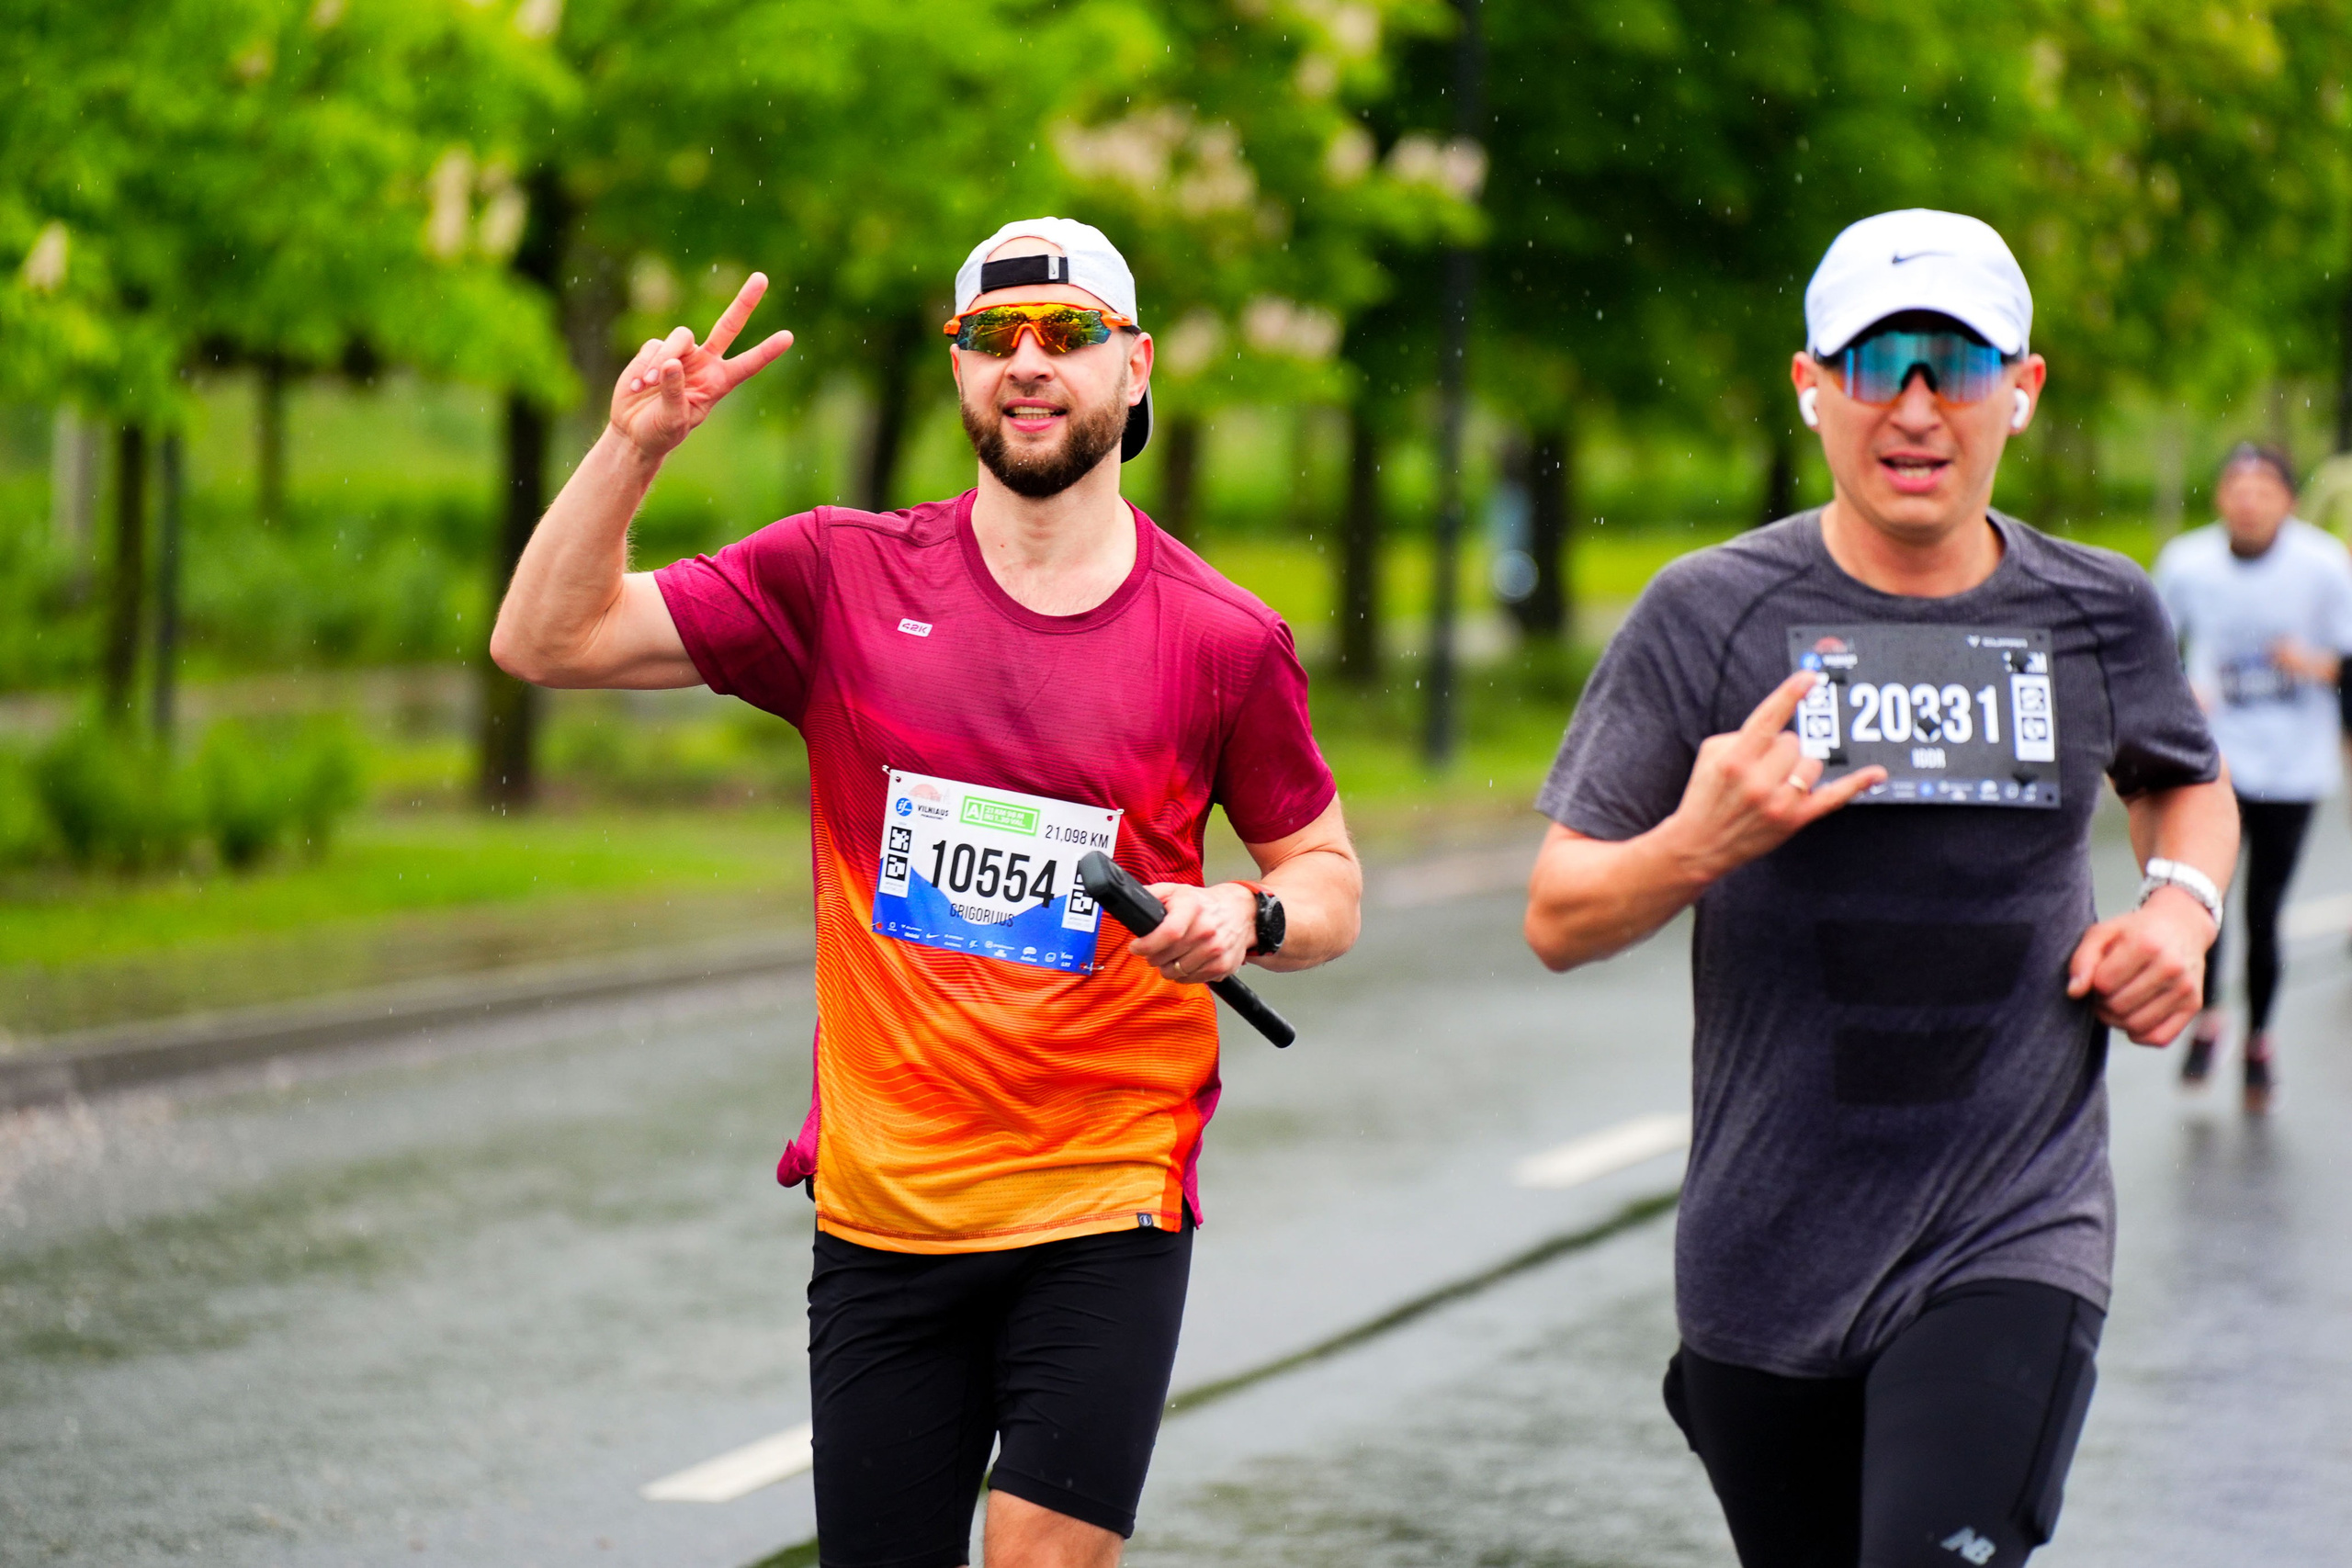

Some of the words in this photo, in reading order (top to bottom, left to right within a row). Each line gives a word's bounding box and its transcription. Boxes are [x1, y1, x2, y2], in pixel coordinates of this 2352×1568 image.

[1849, 682, 2000, 744] 20331
[918, 805, 949, 817] VILNIAUS
[967, 804, 979, 820] A
[1090, 832, 1109, 849] KM
[932, 840, 1057, 908] 10554
[950, 903, 1015, 928] GRIGORIJUS
[1939, 1526, 1996, 1566] NB
